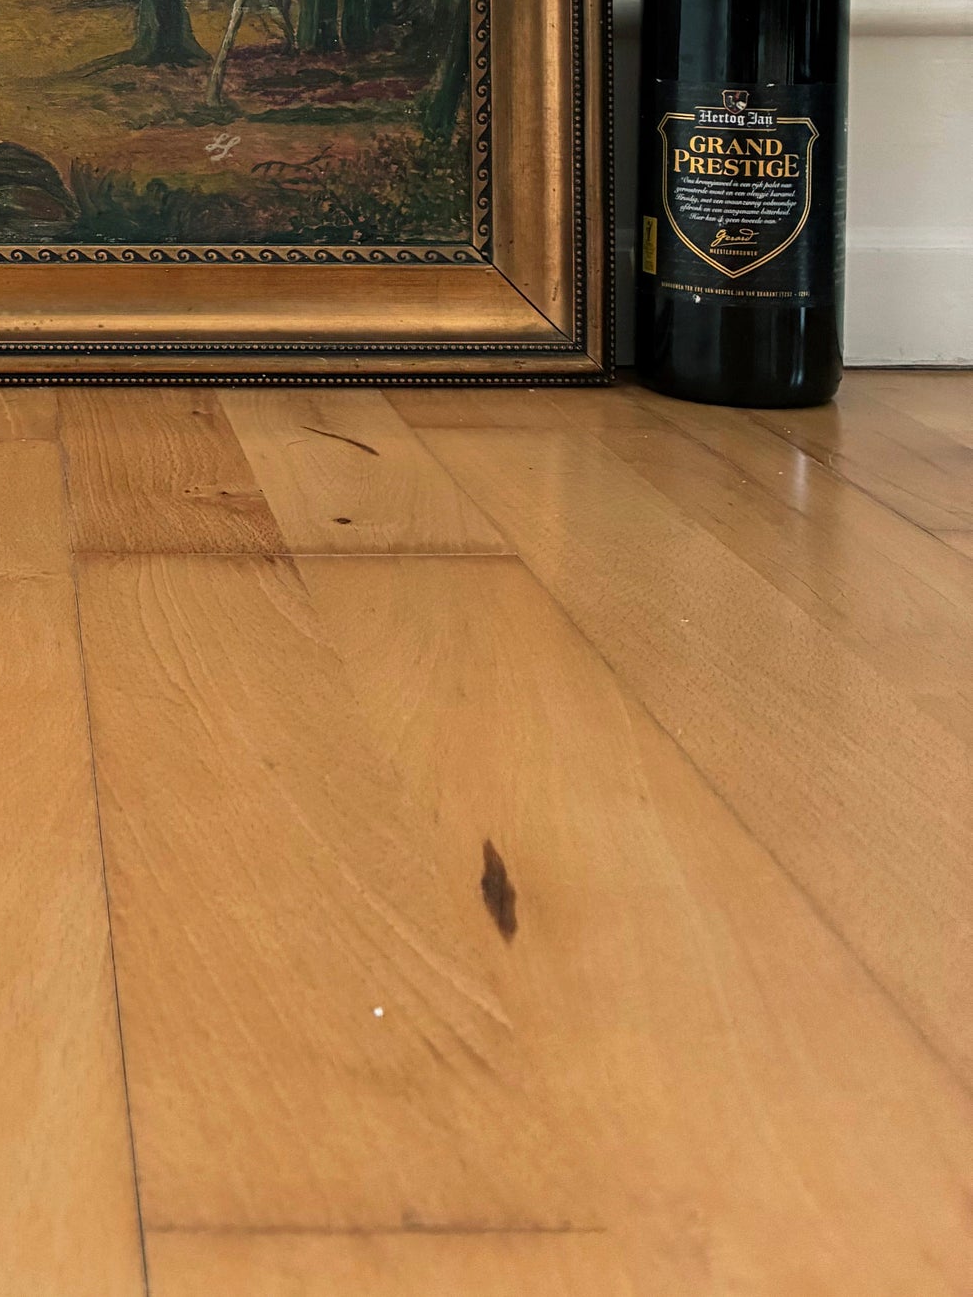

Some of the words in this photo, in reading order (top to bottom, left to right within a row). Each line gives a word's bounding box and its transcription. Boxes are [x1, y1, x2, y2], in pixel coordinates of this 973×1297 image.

[698, 109, 746, 126] Hertog
[746, 112, 773, 127] Jan
[689, 135, 783, 156] GRAND
[673, 148, 800, 178] PRESTIGE
